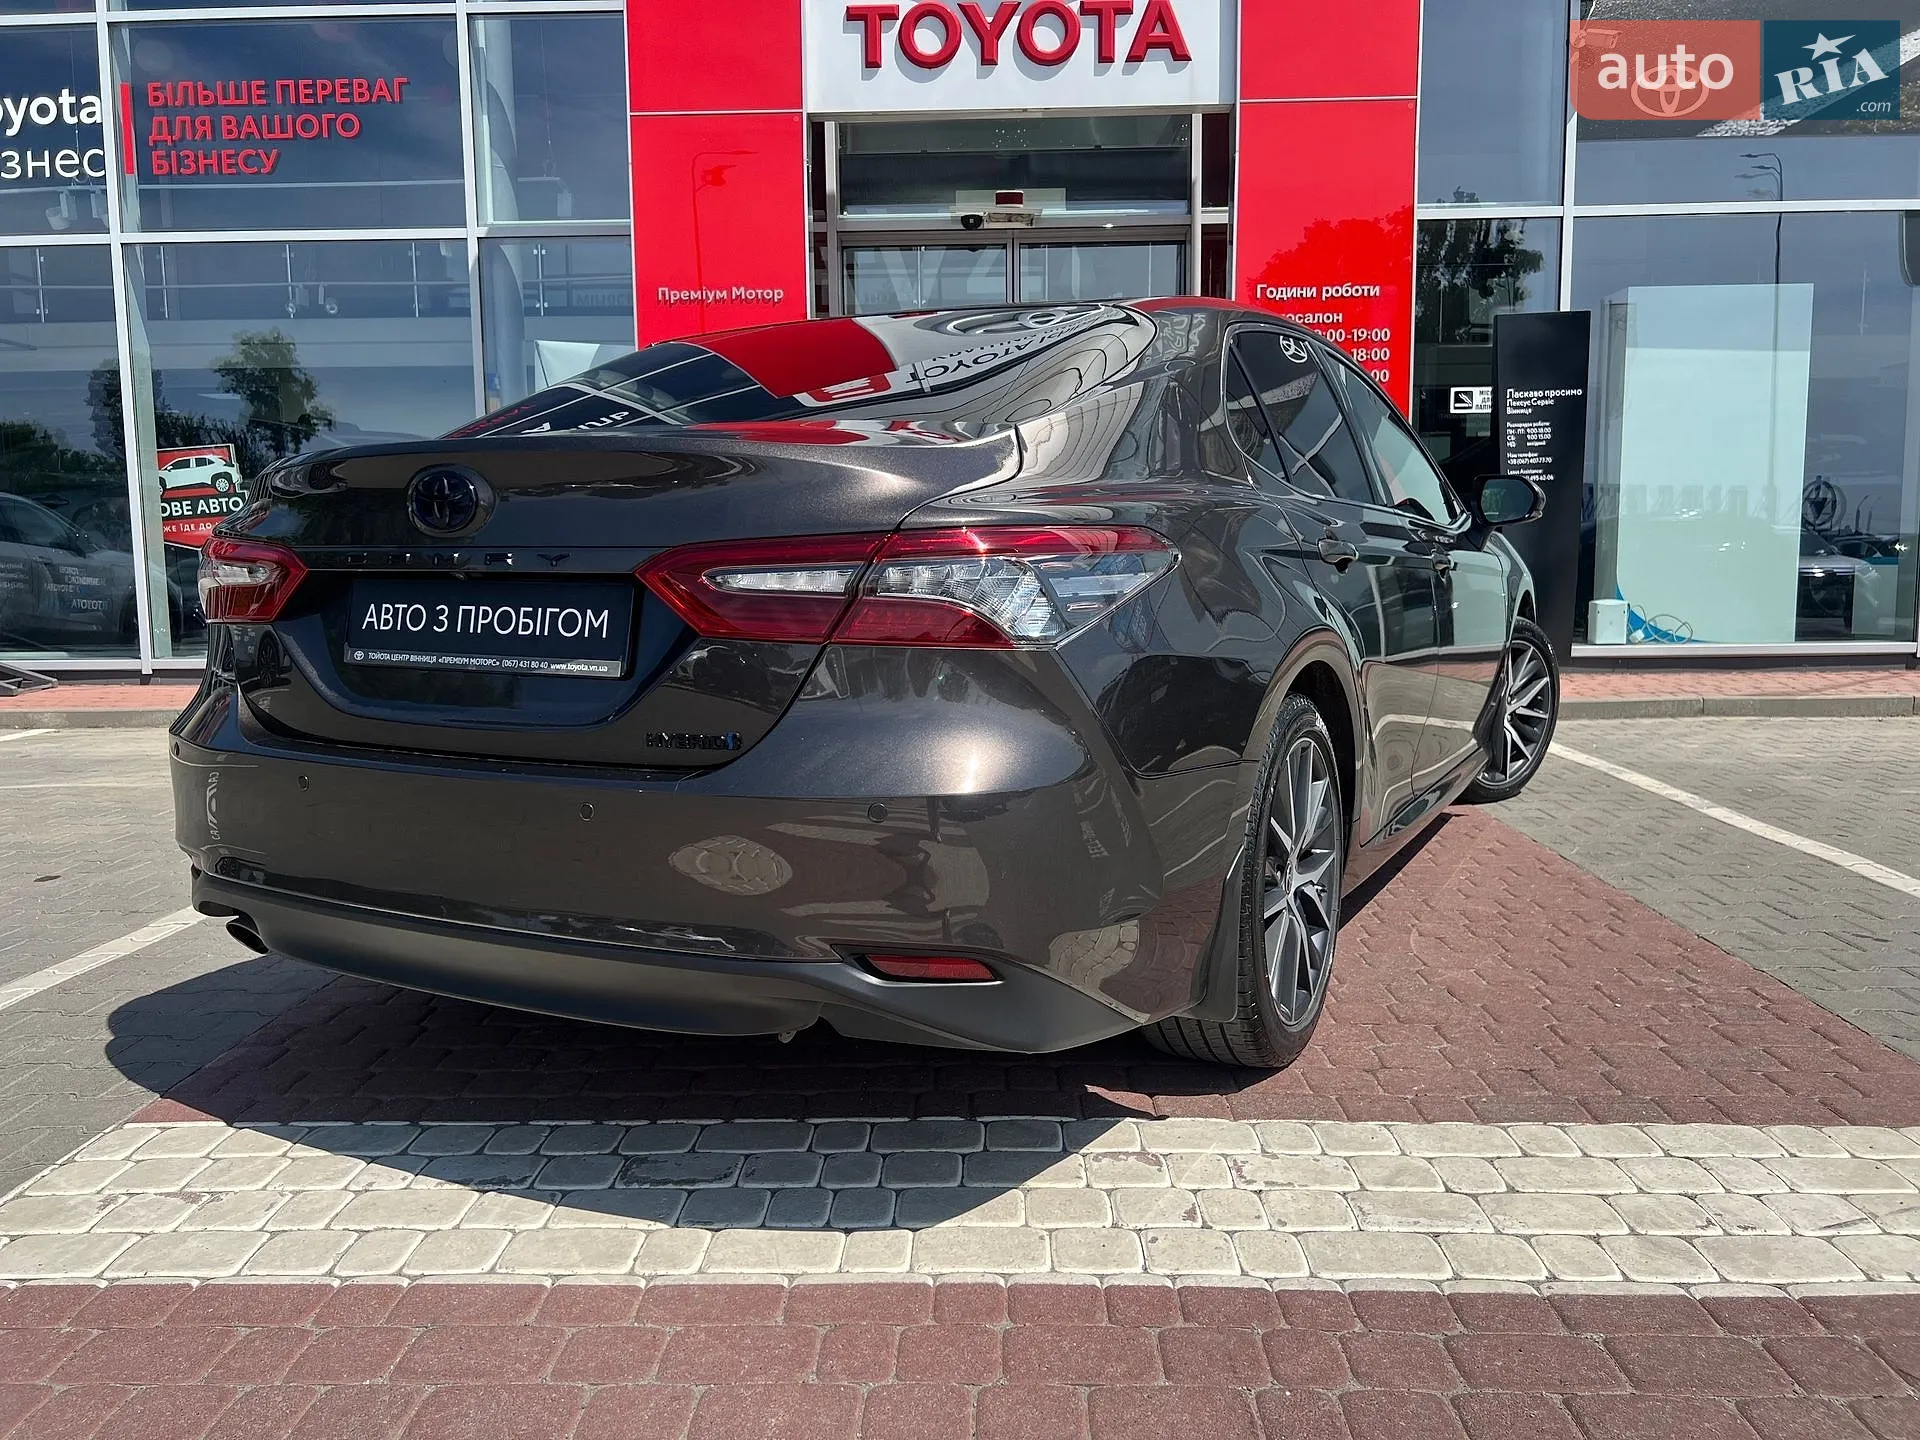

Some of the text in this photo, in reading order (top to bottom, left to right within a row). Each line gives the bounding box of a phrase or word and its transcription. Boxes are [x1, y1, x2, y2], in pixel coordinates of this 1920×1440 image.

[846, 0, 1192, 69] TOYOTA
[147, 76, 409, 107] БІЛЬШЕ ПЕРЕВАГ
[0, 88, 103, 137] yota
[148, 112, 361, 146] ДЛЯ ВАШОГО
[151, 148, 279, 176] БІЗНЕСУ
[658, 285, 784, 304] Преміум Мотор
[1256, 282, 1381, 301] Години роботи
[1544, 389, 1582, 398] просимо
[197, 496, 244, 516] АВТО
[361, 603, 427, 632] АВТО
[456, 604, 609, 639] ПРОБІГОМ
[368, 651, 391, 661] ТОЙОТА
[391, 653, 410, 663] ЦЕНТР
[501, 658, 519, 669] (067)
[519, 660, 530, 669] 431
[530, 660, 540, 669] 80
[540, 660, 549, 669] 40
